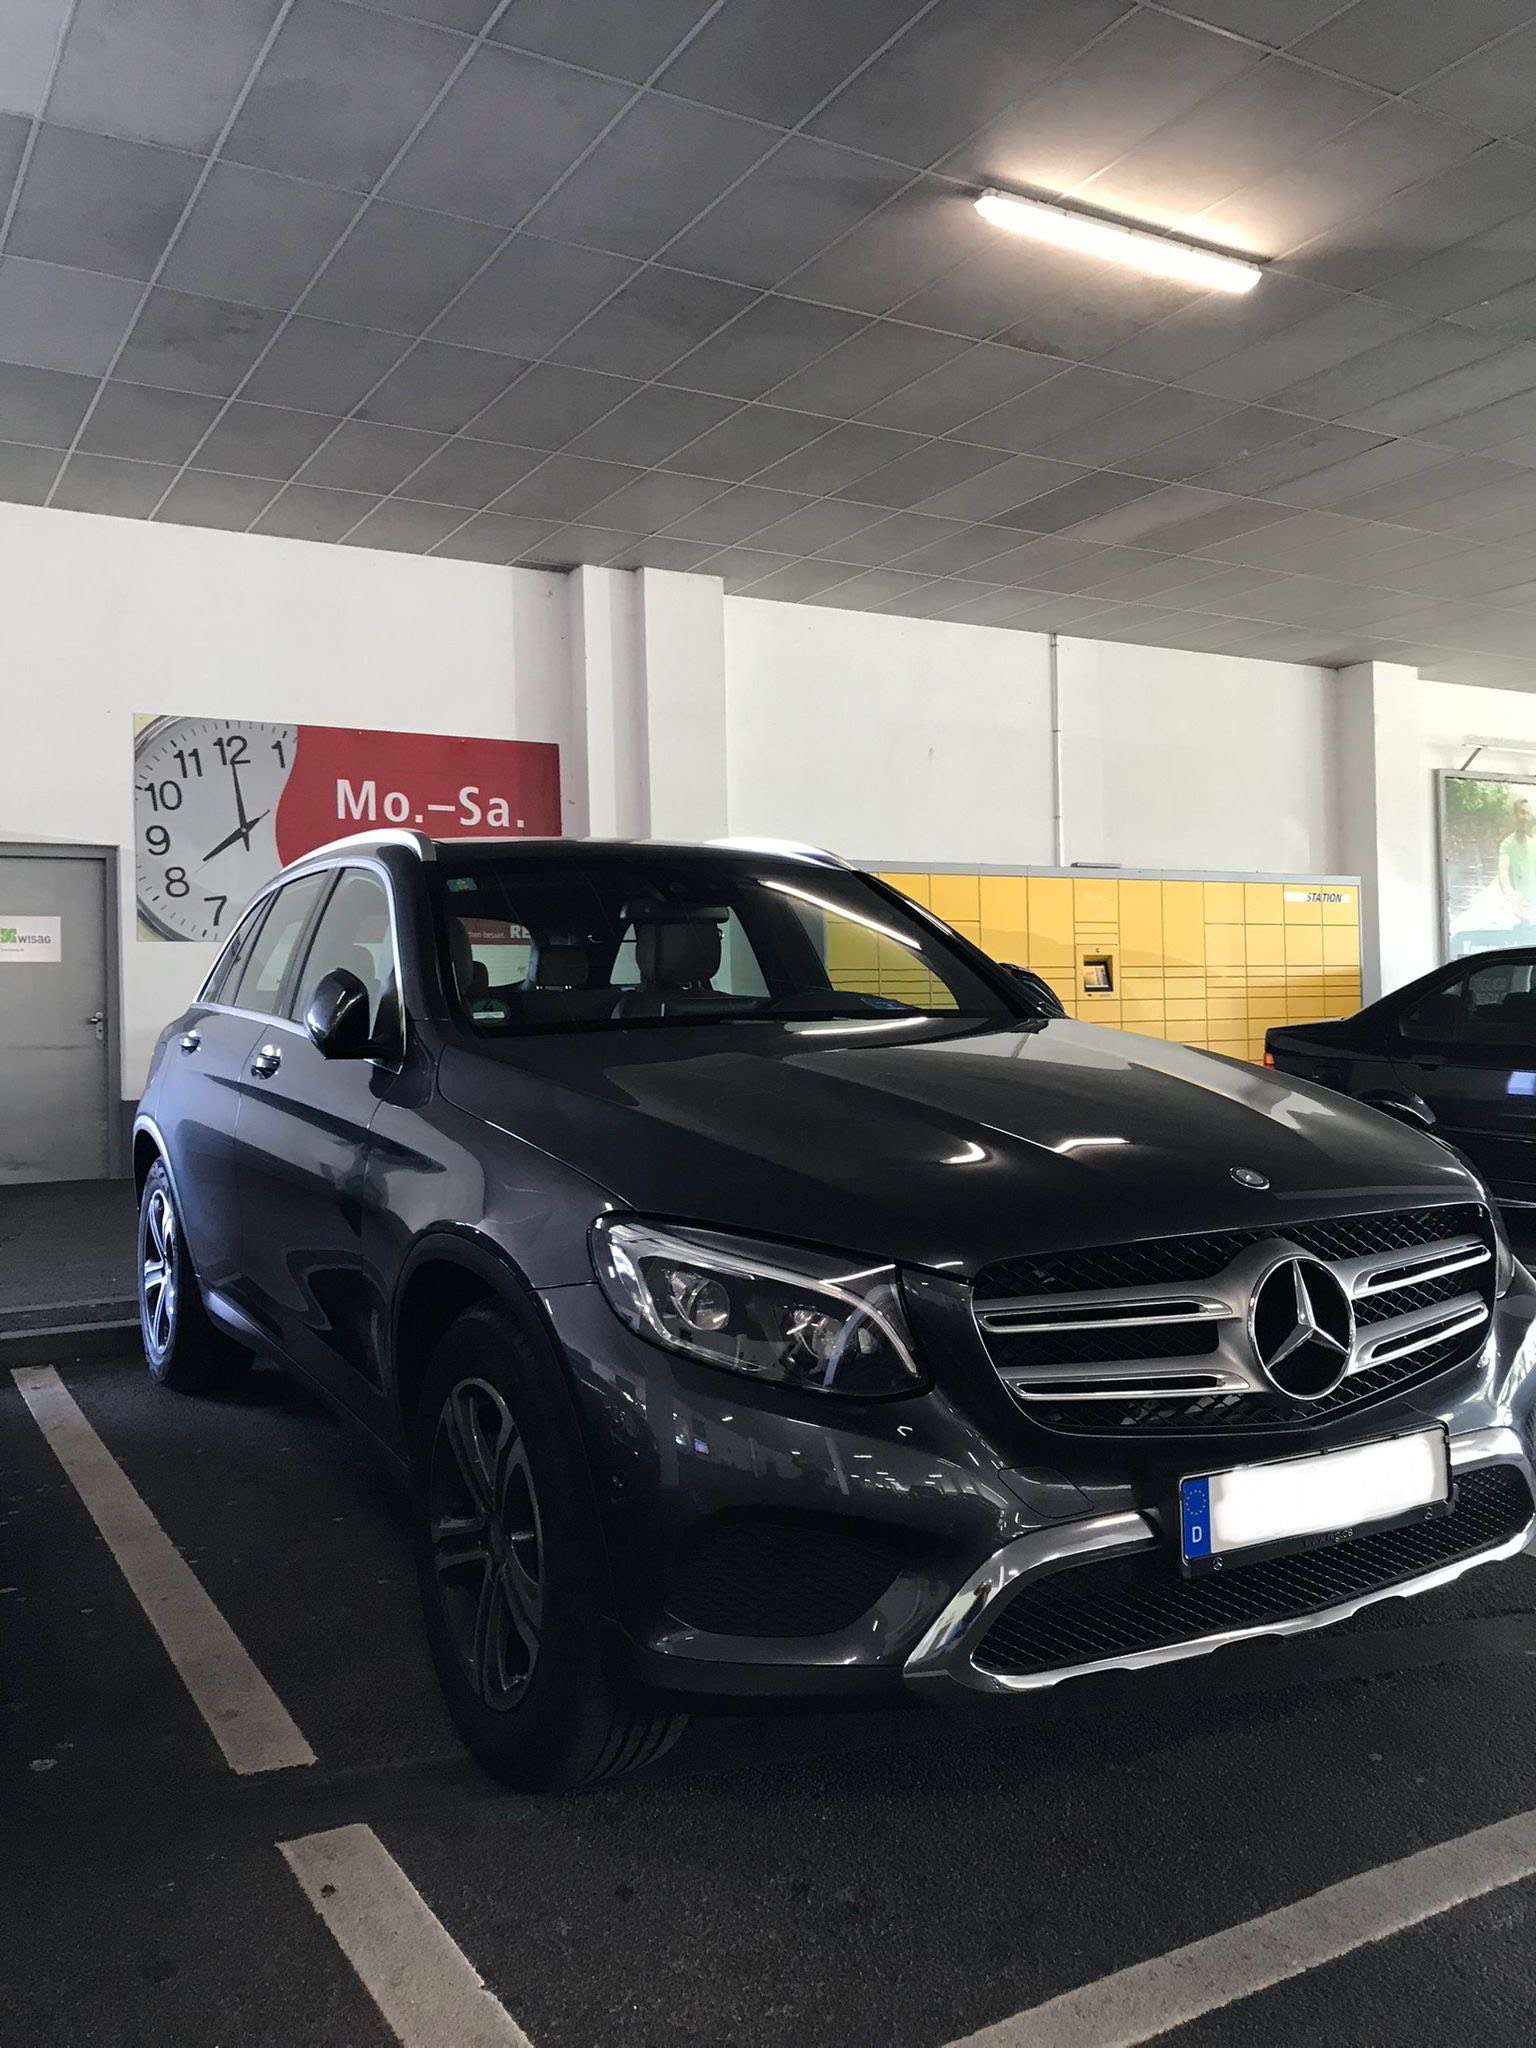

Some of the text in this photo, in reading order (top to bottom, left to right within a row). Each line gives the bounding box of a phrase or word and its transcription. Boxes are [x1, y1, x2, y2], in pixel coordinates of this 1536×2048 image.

[173, 748, 203, 778] 11
[213, 735, 251, 766] 12
[271, 740, 285, 768] 1
[144, 780, 182, 811] 10
[145, 825, 170, 856] 9
[164, 866, 190, 897] 8
[204, 895, 228, 926] 7
[1307, 892, 1342, 903] STATION
[1191, 1526, 1203, 1544] D
